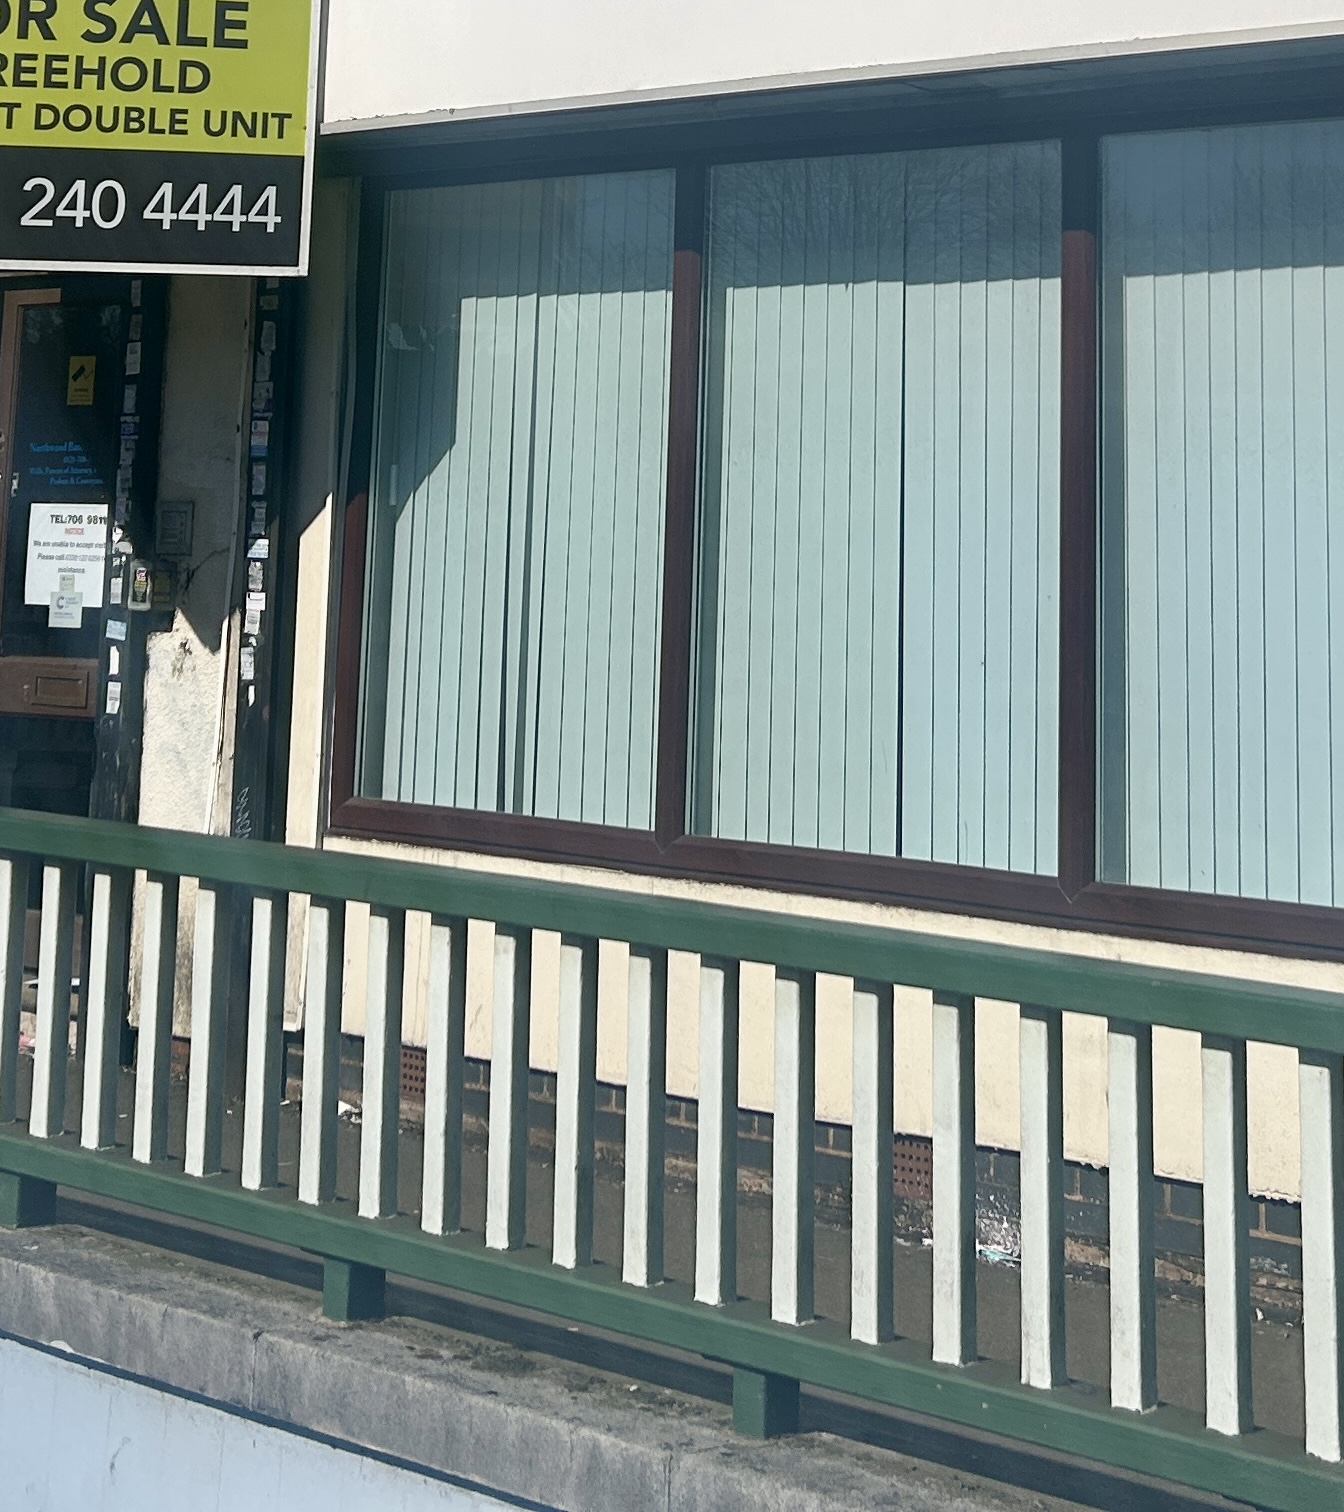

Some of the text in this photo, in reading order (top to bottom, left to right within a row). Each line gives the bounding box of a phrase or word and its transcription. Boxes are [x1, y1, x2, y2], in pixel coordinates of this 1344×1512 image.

[33, 102, 188, 136] DOUBLE
[202, 110, 292, 140] UNIT
[20, 176, 126, 230] 240
[143, 182, 282, 234] 4444
